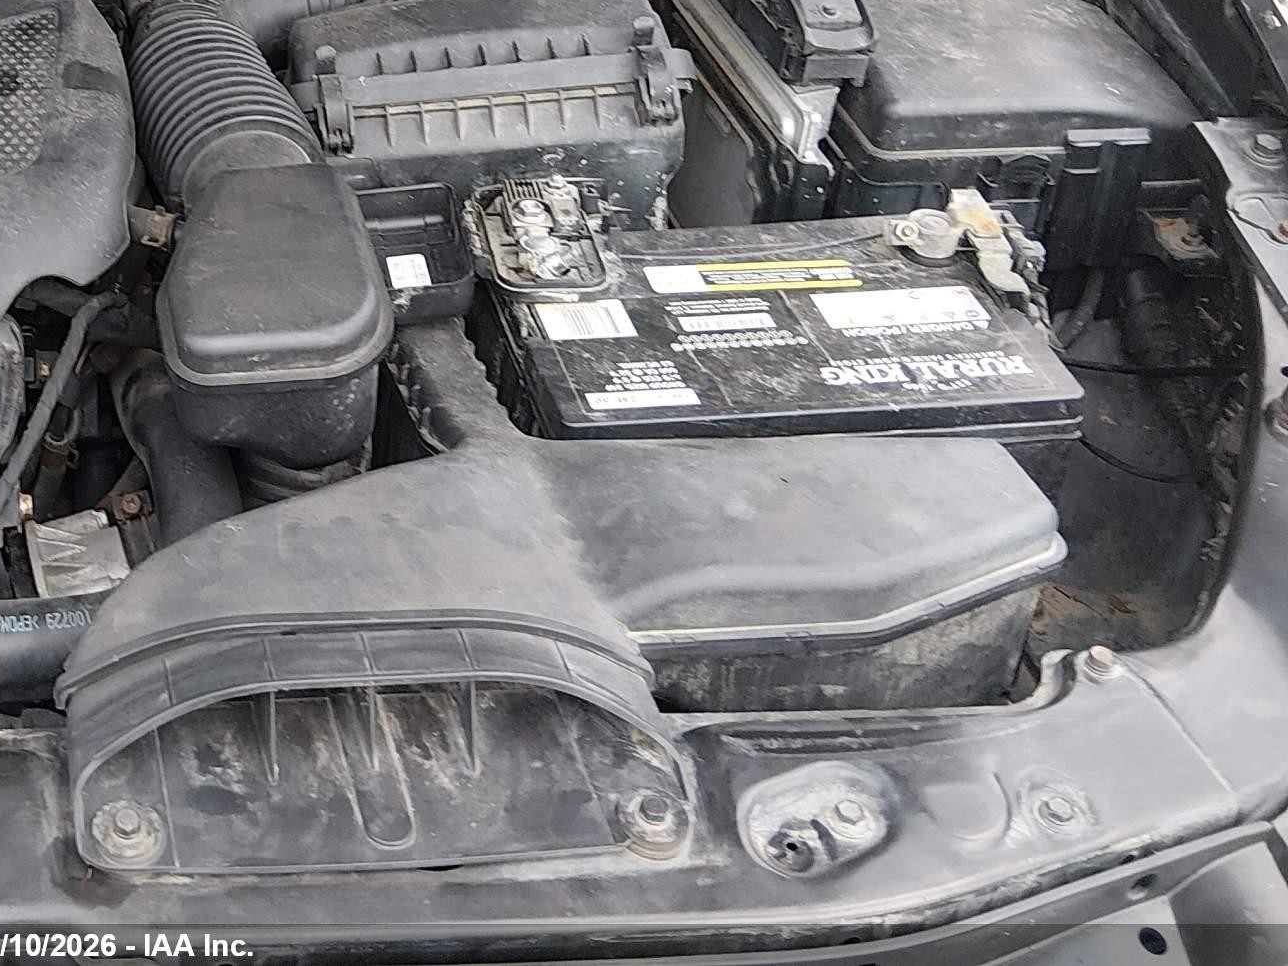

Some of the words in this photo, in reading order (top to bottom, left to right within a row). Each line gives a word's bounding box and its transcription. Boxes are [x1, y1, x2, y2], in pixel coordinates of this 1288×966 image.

[909, 321, 974, 335] DANGER
[818, 363, 911, 386] KING
[907, 355, 1034, 380] RURAL
